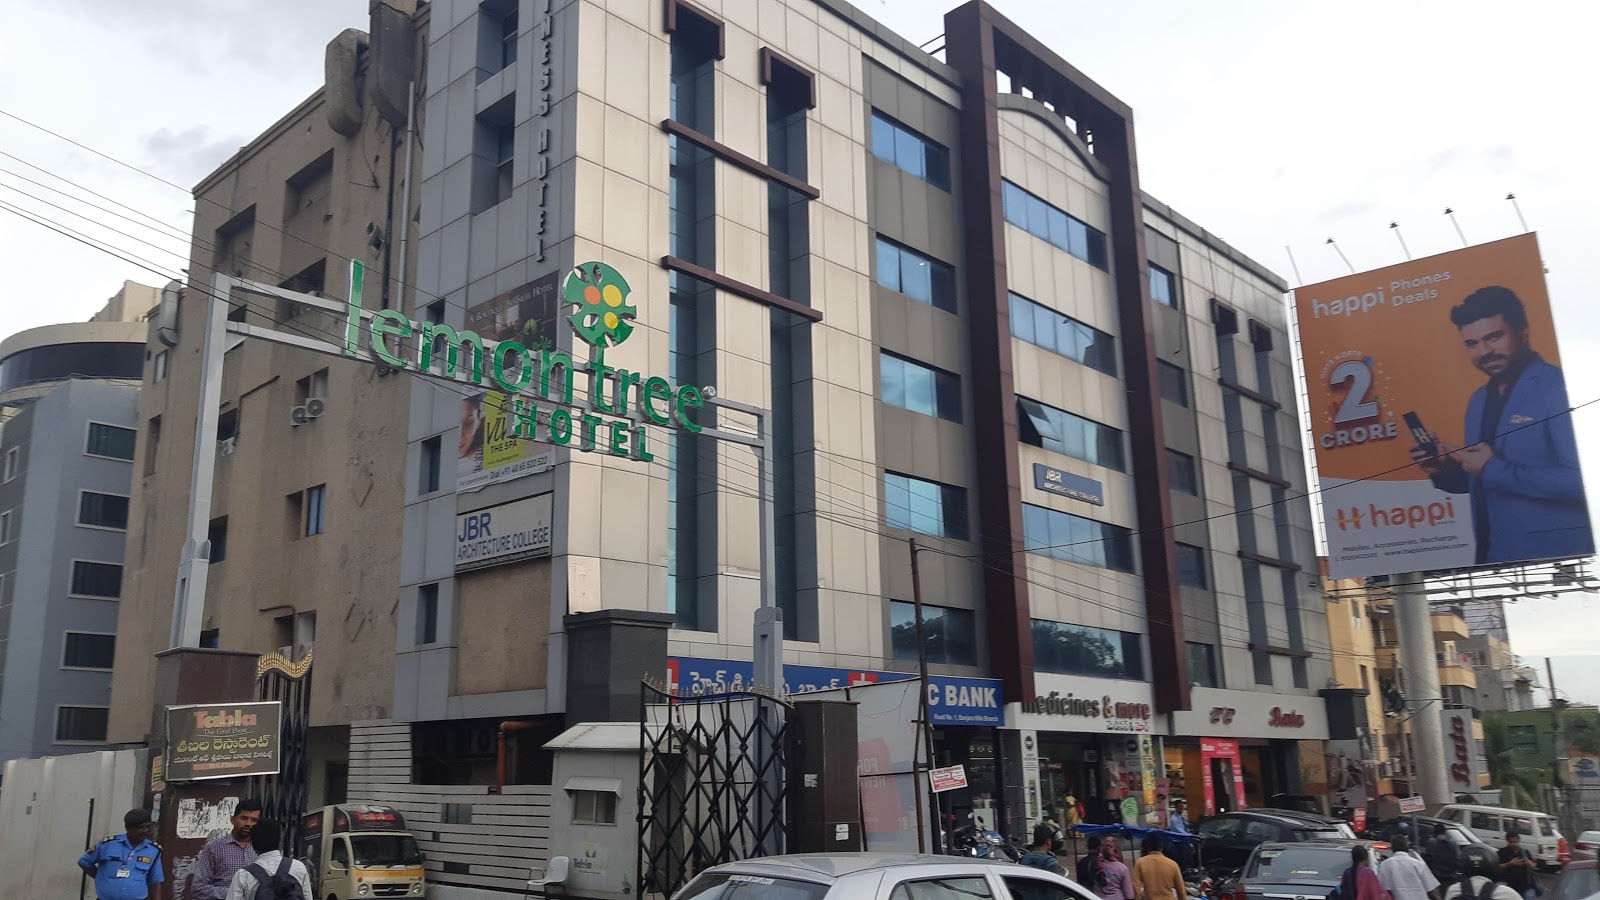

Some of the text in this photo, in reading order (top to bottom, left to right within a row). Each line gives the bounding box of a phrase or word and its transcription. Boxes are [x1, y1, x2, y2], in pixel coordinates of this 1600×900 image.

[536, 127, 550, 263] HOTEL
[1390, 270, 1452, 292] Phones
[1311, 286, 1385, 319] happi
[1392, 288, 1439, 307] Deals
[344, 258, 704, 433] lemon tree
[1329, 359, 1380, 425] 2
[513, 400, 654, 462] HOTEL
[1319, 421, 1398, 449] CRORE
[490, 438, 518, 455] THE SPA
[1369, 495, 1456, 529] happi
[458, 512, 492, 544] JBR
[456, 527, 549, 561] ARCHITECTURE COLLEGE
[944, 684, 998, 708] BANK
[1021, 690, 1151, 720] medicines & more
[193, 709, 257, 729] Tabla
[203, 728, 216, 736] The
[213, 734, 271, 754] రెస్టారెంట్
[1448, 714, 1471, 788] Bata
[221, 761, 240, 769] Floor
